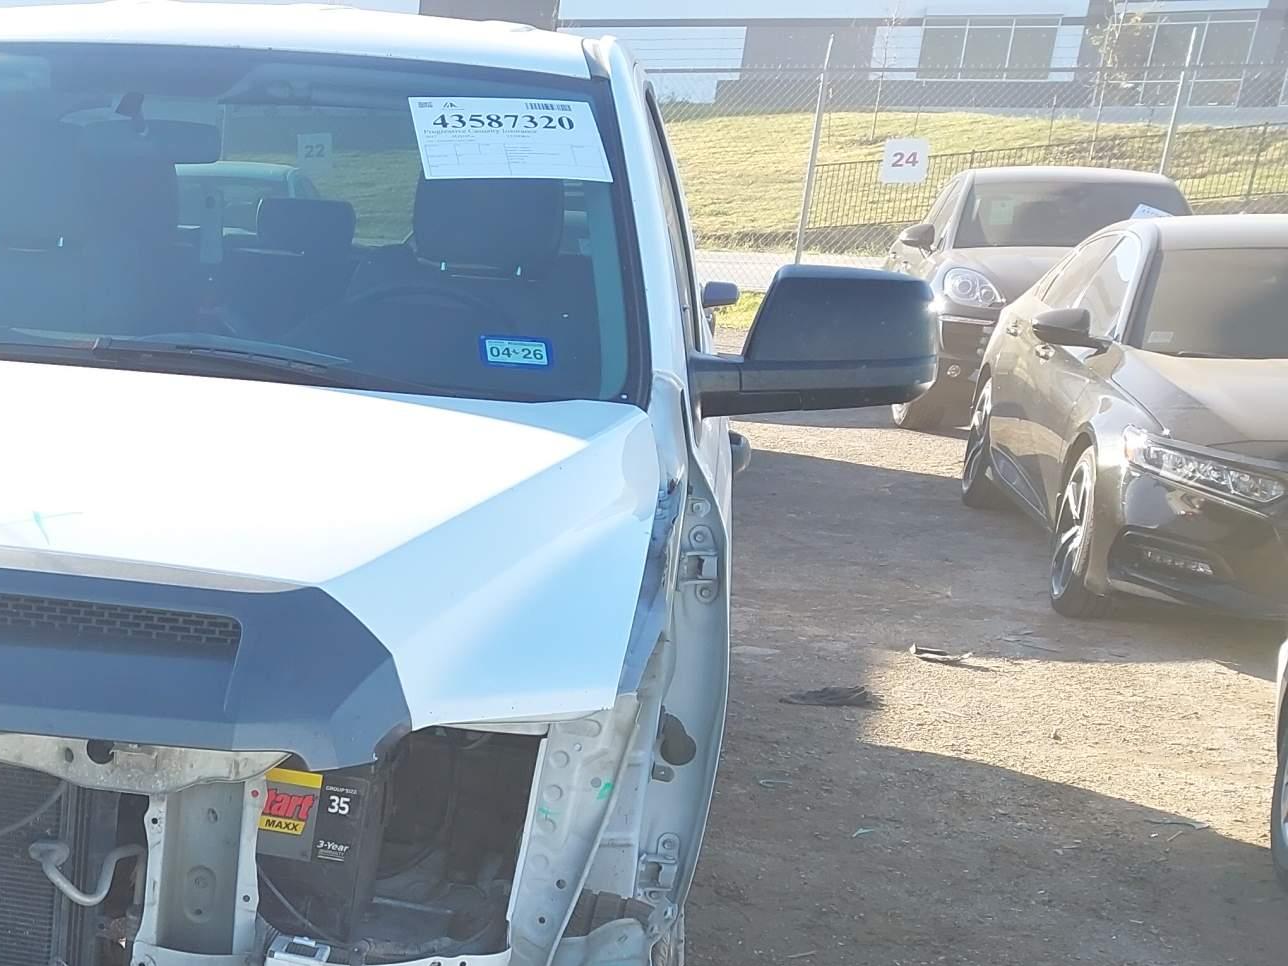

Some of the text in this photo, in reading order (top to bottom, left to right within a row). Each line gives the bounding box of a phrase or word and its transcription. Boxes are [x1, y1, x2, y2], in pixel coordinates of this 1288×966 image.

[432, 113, 575, 131] 43587320
[304, 144, 325, 158] 22
[891, 151, 919, 167] 24
[490, 346, 544, 360] 04 26
[327, 795, 350, 815] 35
[264, 819, 299, 832] MAXX
[316, 840, 349, 852] 3-Year
